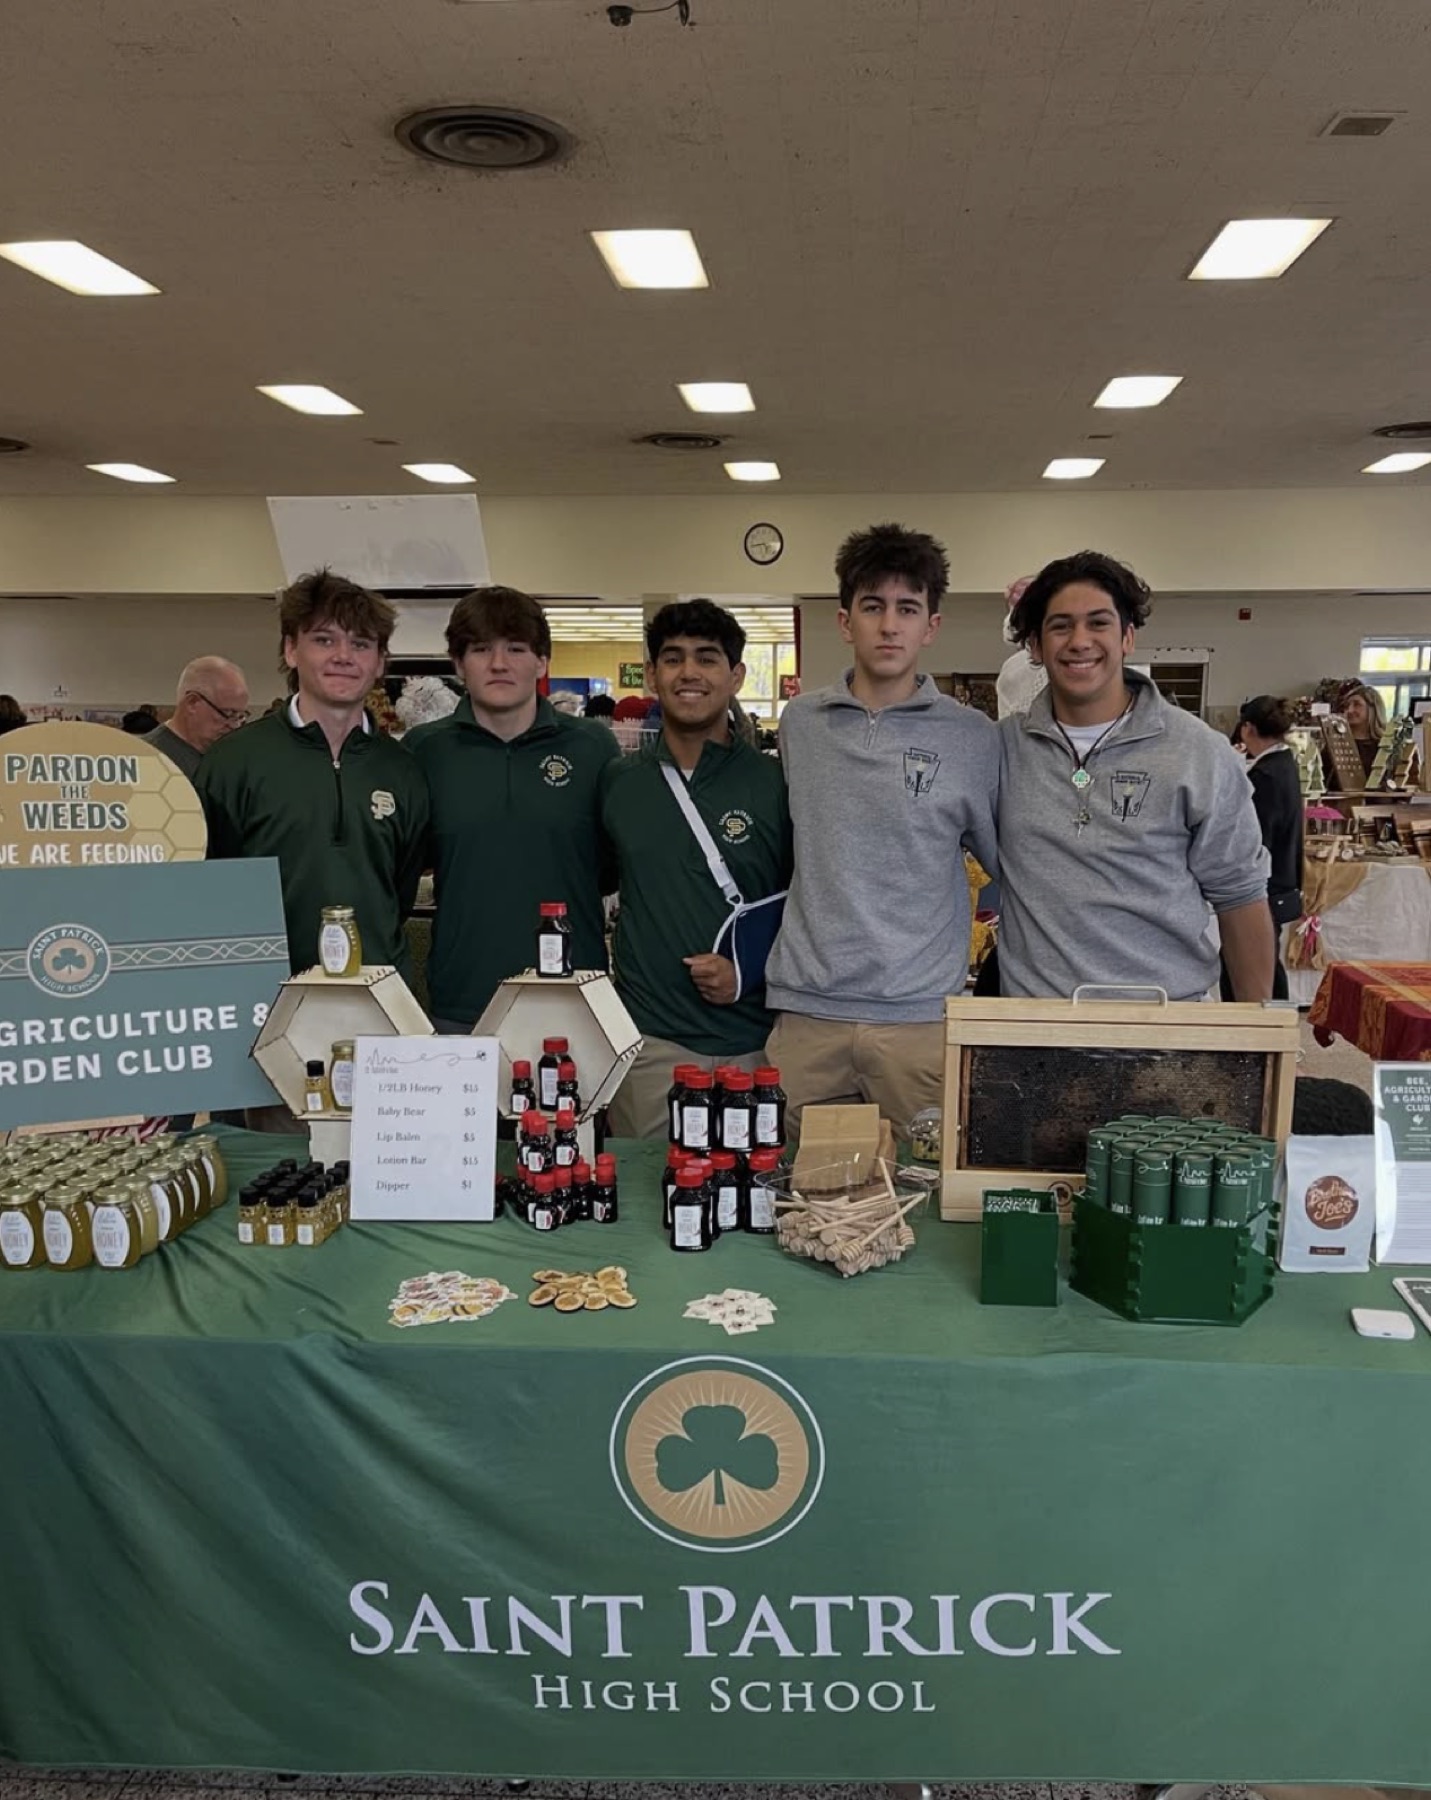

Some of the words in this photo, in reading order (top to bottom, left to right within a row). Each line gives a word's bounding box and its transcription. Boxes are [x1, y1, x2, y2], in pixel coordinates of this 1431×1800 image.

[5, 754, 139, 784] PARDON
[60, 785, 89, 799] THE
[22, 801, 129, 831] WEEDS
[30, 844, 71, 864] ARE
[81, 843, 165, 864] FEEDING
[32, 931, 57, 960] SAINT
[61, 928, 104, 956] PATRICK
[117, 1044, 213, 1076] CLUB
[410, 1082, 442, 1095] Honey
[462, 1083, 479, 1094] $15
[377, 1106, 401, 1118] Baby
[403, 1107, 426, 1117] Bear
[464, 1106, 476, 1117] $5
[377, 1131, 393, 1143] Lip
[395, 1131, 421, 1142] Balm
[464, 1132, 475, 1143] $5
[377, 1155, 408, 1165] Lotion
[411, 1156, 427, 1165] Bar
[462, 1156, 479, 1166] $15
[376, 1180, 410, 1192] Dipper
[349, 1580, 643, 1657] SAINT
[679, 1585, 1121, 1657] PATRICK
[531, 1674, 681, 1711] HIGH
[710, 1676, 936, 1713] SCHOOL
